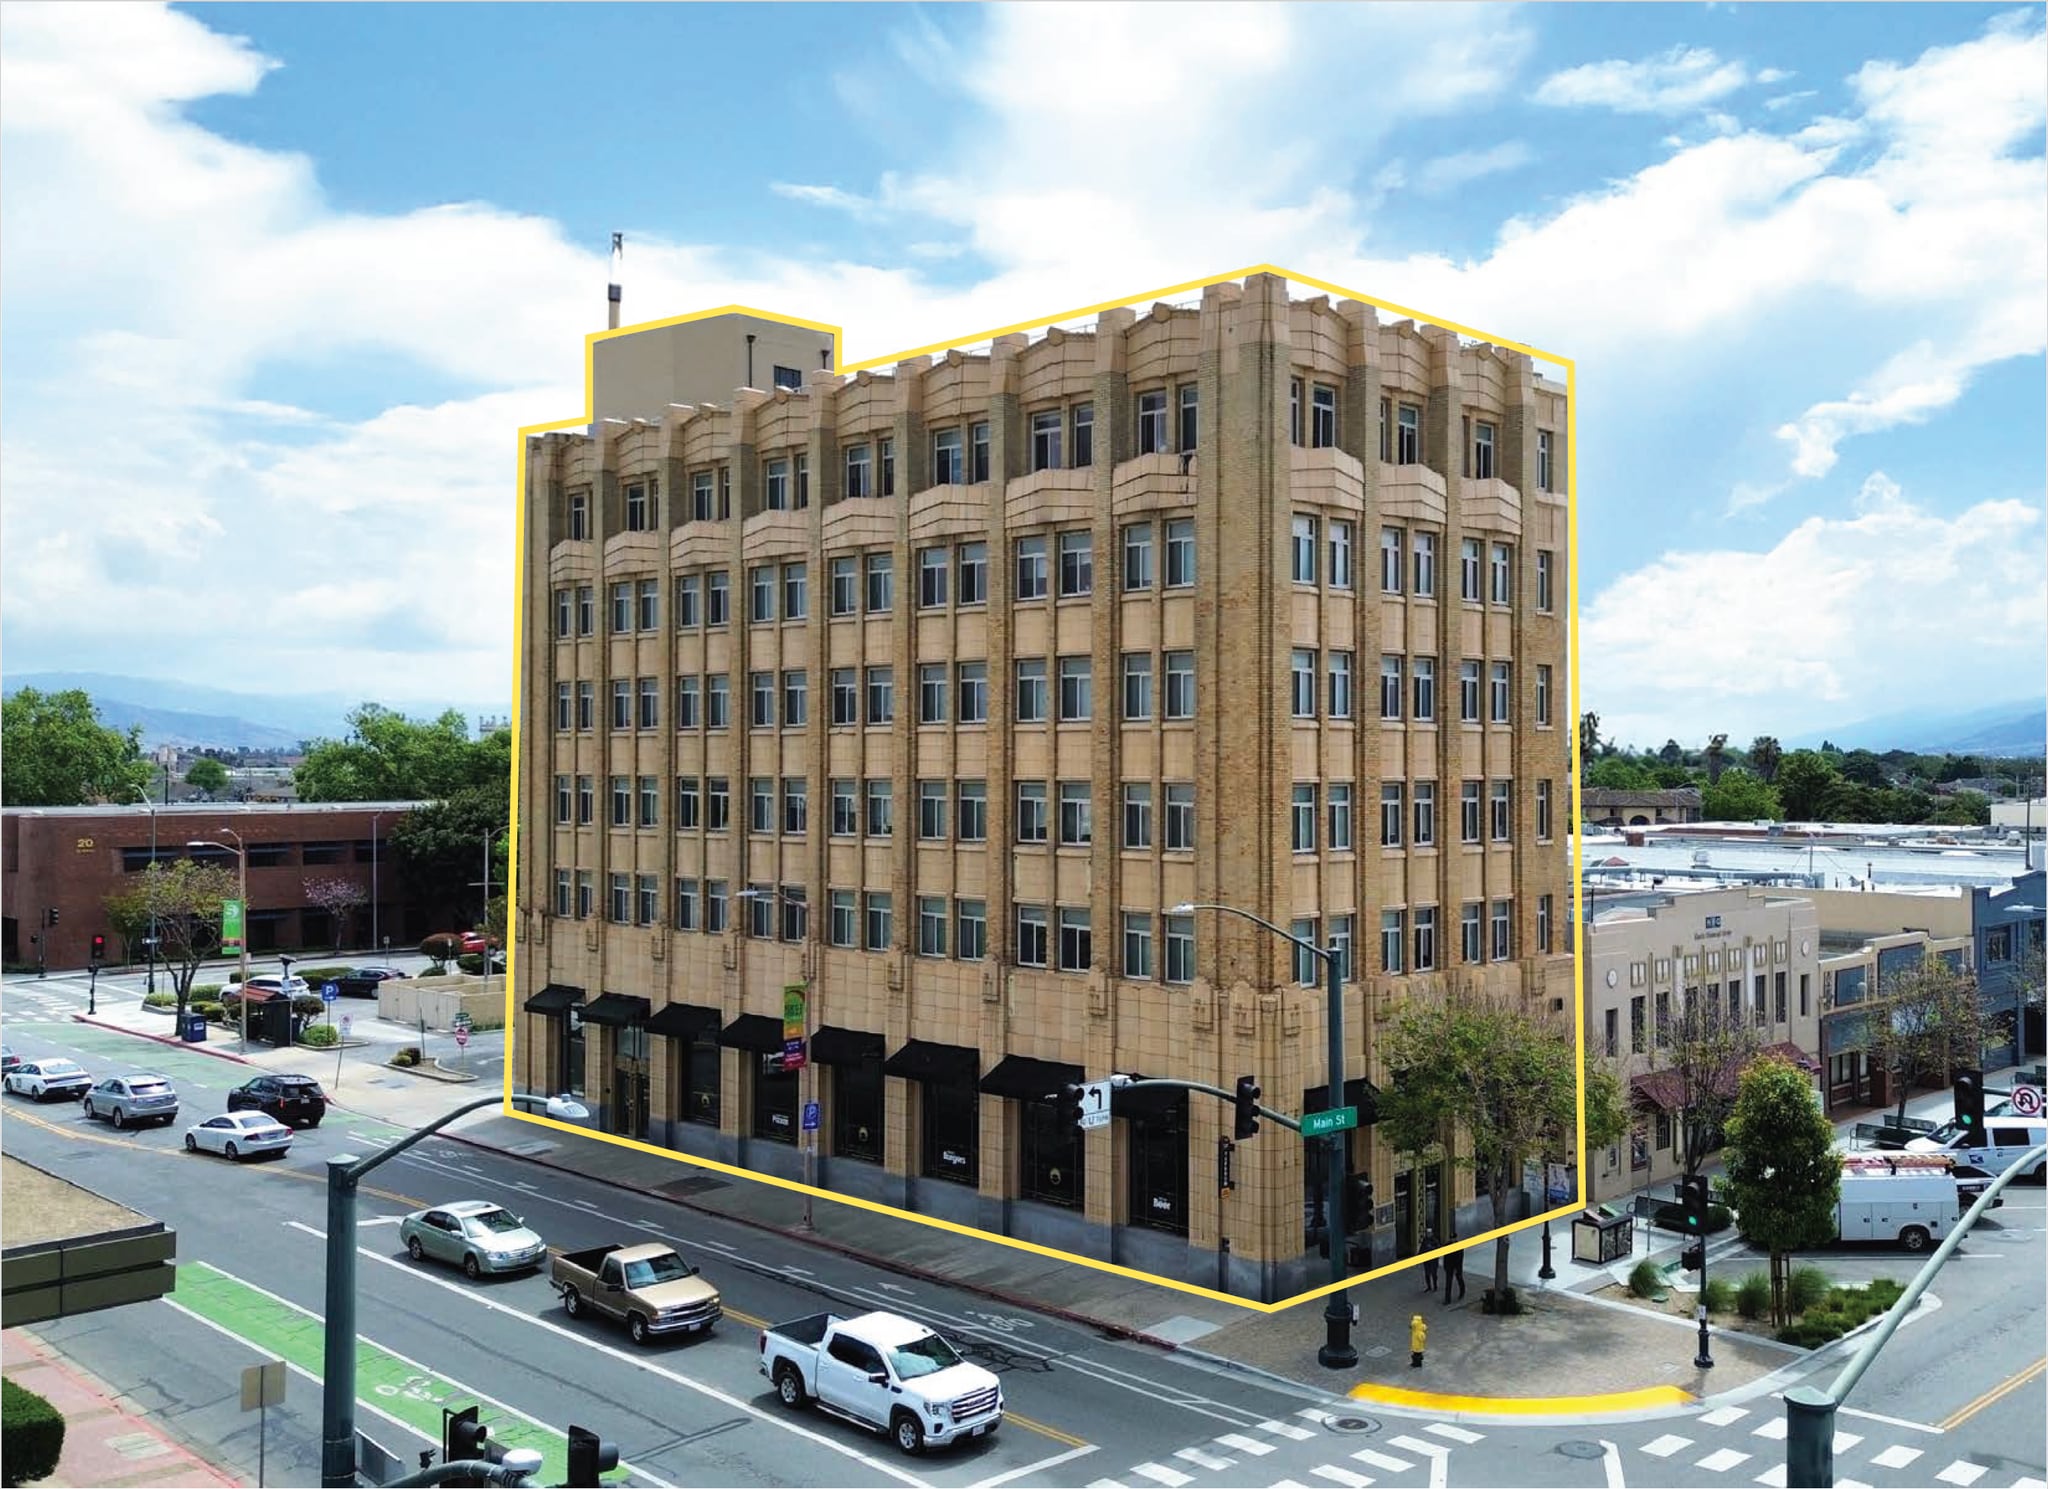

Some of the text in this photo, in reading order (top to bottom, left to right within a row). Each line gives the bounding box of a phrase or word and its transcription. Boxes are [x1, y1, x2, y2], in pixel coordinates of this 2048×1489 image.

[77, 838, 94, 848] 20
[1313, 1114, 1346, 1129] Main St
